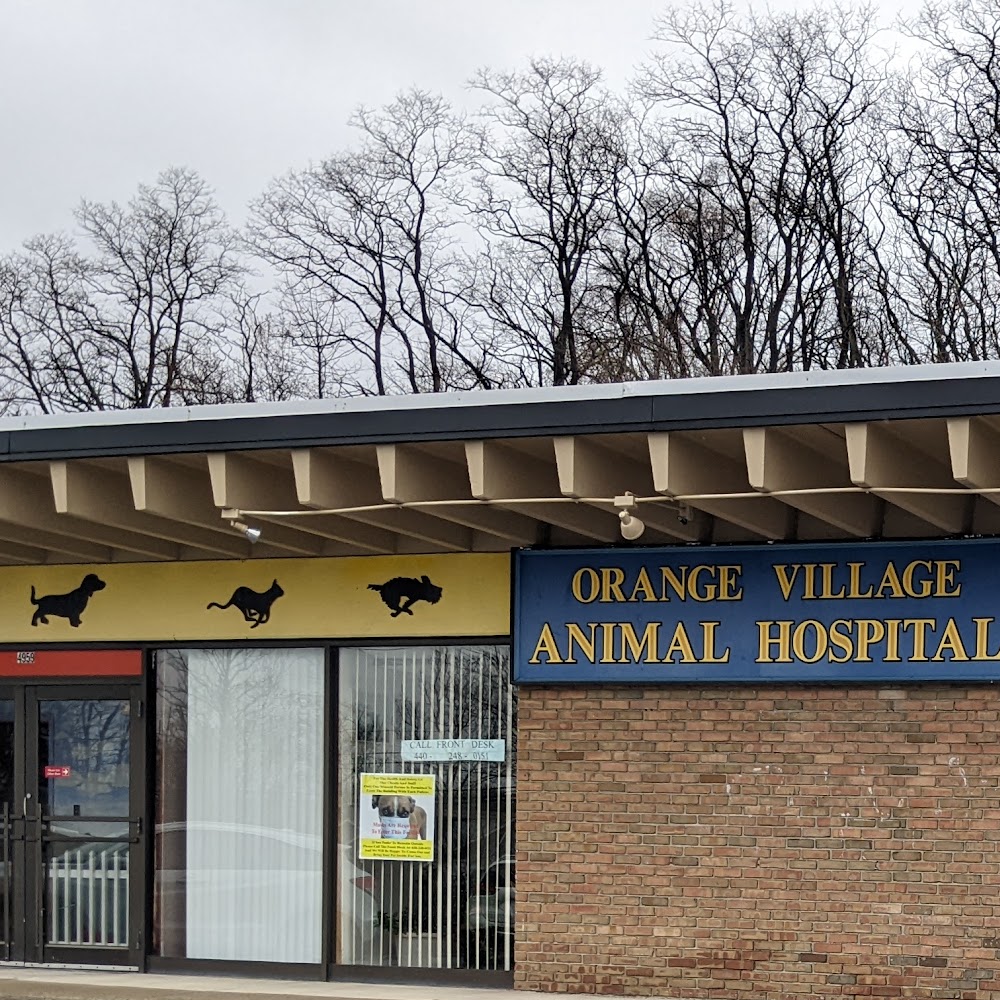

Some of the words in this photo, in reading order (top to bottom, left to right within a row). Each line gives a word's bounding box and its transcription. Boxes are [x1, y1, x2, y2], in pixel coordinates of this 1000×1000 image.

[571, 565, 743, 603] ORANGE
[773, 560, 962, 600] VILLAGE
[17, 652, 35, 663] 4959
[529, 621, 730, 664] ANIMAL
